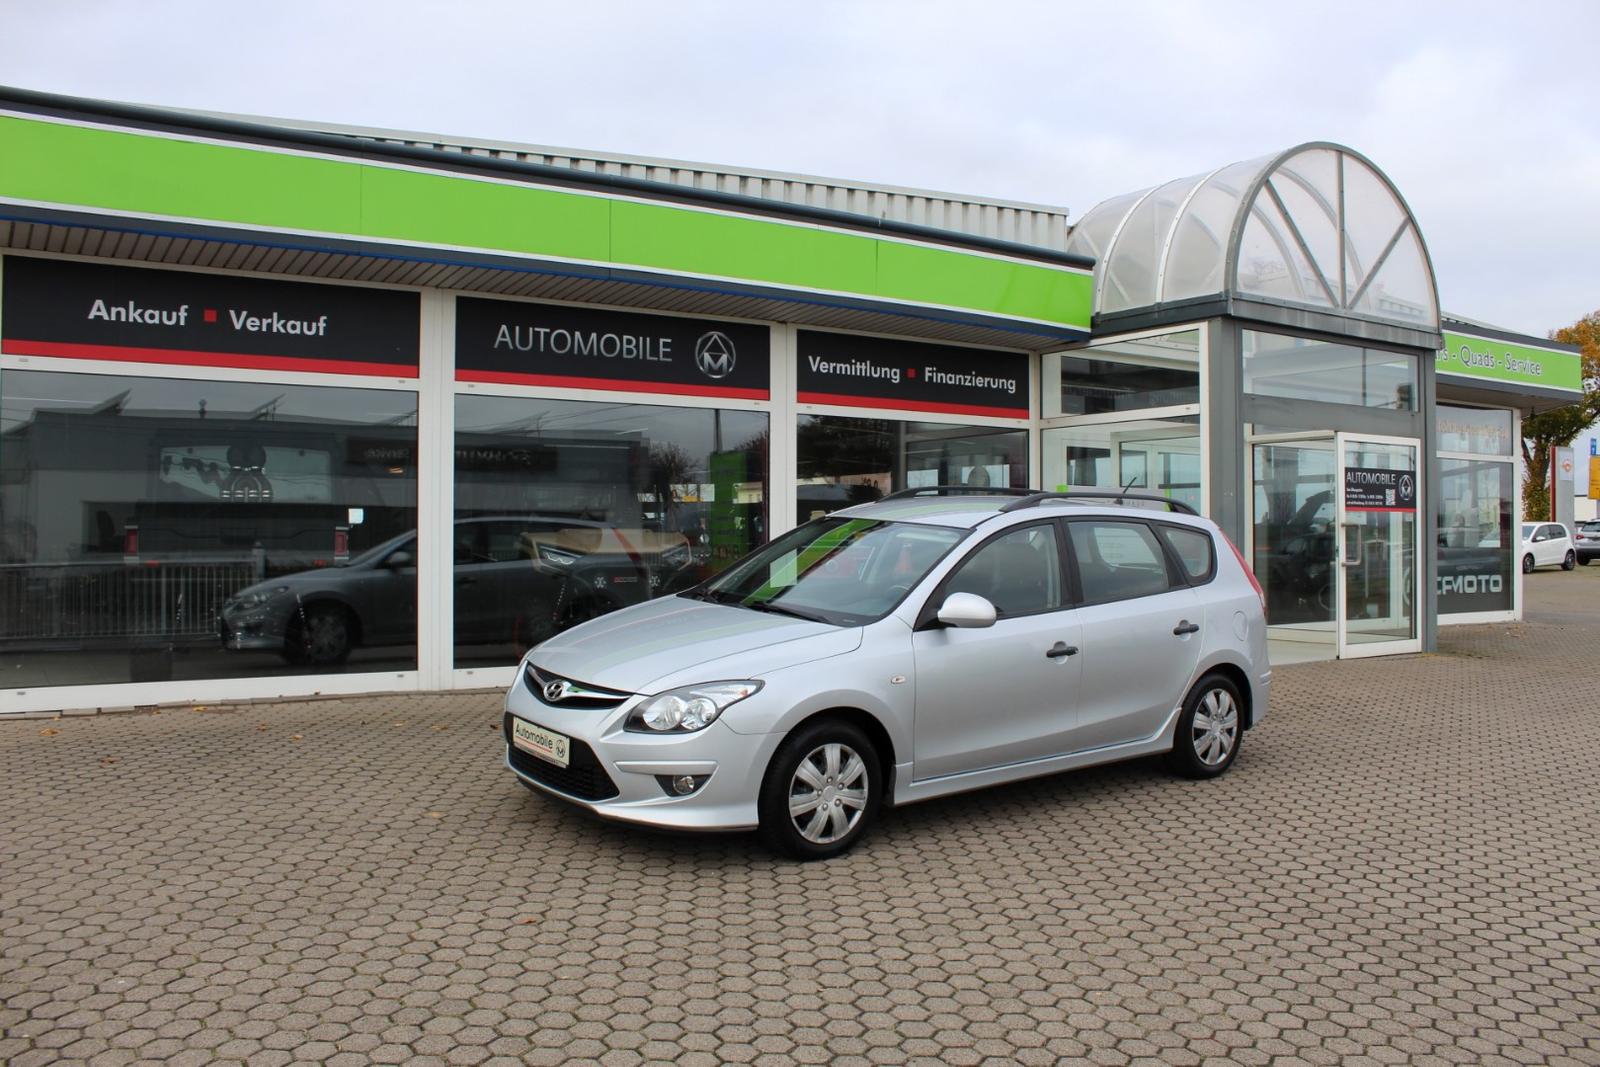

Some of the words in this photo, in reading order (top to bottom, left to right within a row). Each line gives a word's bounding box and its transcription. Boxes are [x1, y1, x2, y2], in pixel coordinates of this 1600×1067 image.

[88, 299, 189, 326] Ankauf
[229, 309, 328, 336] Verkauf
[493, 324, 673, 362] AUTOMOBILE
[808, 355, 900, 383] Vermittlung
[924, 366, 1016, 394] Finanzierung
[1460, 345, 1495, 368] Quads
[1505, 353, 1542, 376] Service
[1346, 471, 1396, 485] AUTOMOBILE
[515, 723, 553, 749] Automobile
